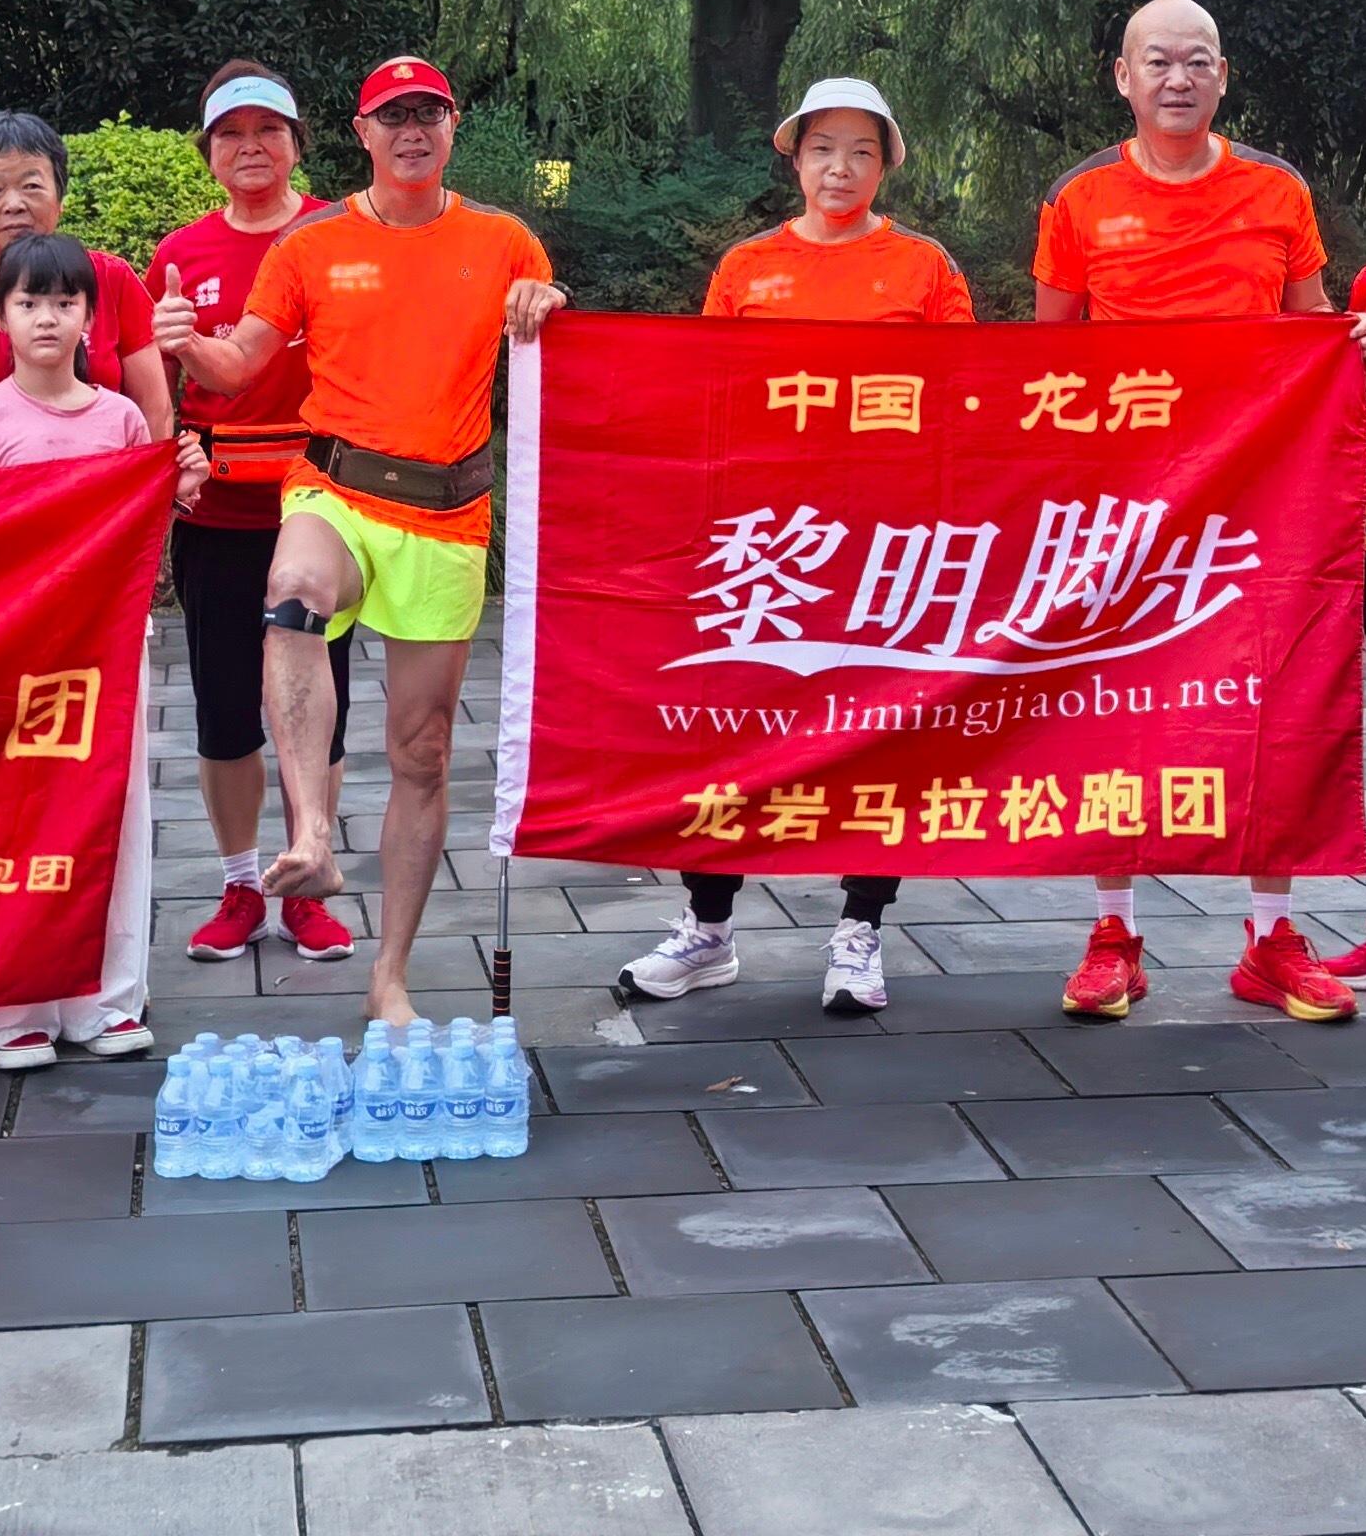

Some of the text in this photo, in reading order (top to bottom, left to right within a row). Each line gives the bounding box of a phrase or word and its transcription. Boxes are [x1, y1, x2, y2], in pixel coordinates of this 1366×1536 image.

[687, 493, 1262, 657] 黎明脚步
[657, 672, 1262, 737] www.limingjiaobu.net
[680, 766, 1227, 846] 龙岩马拉松跑团
